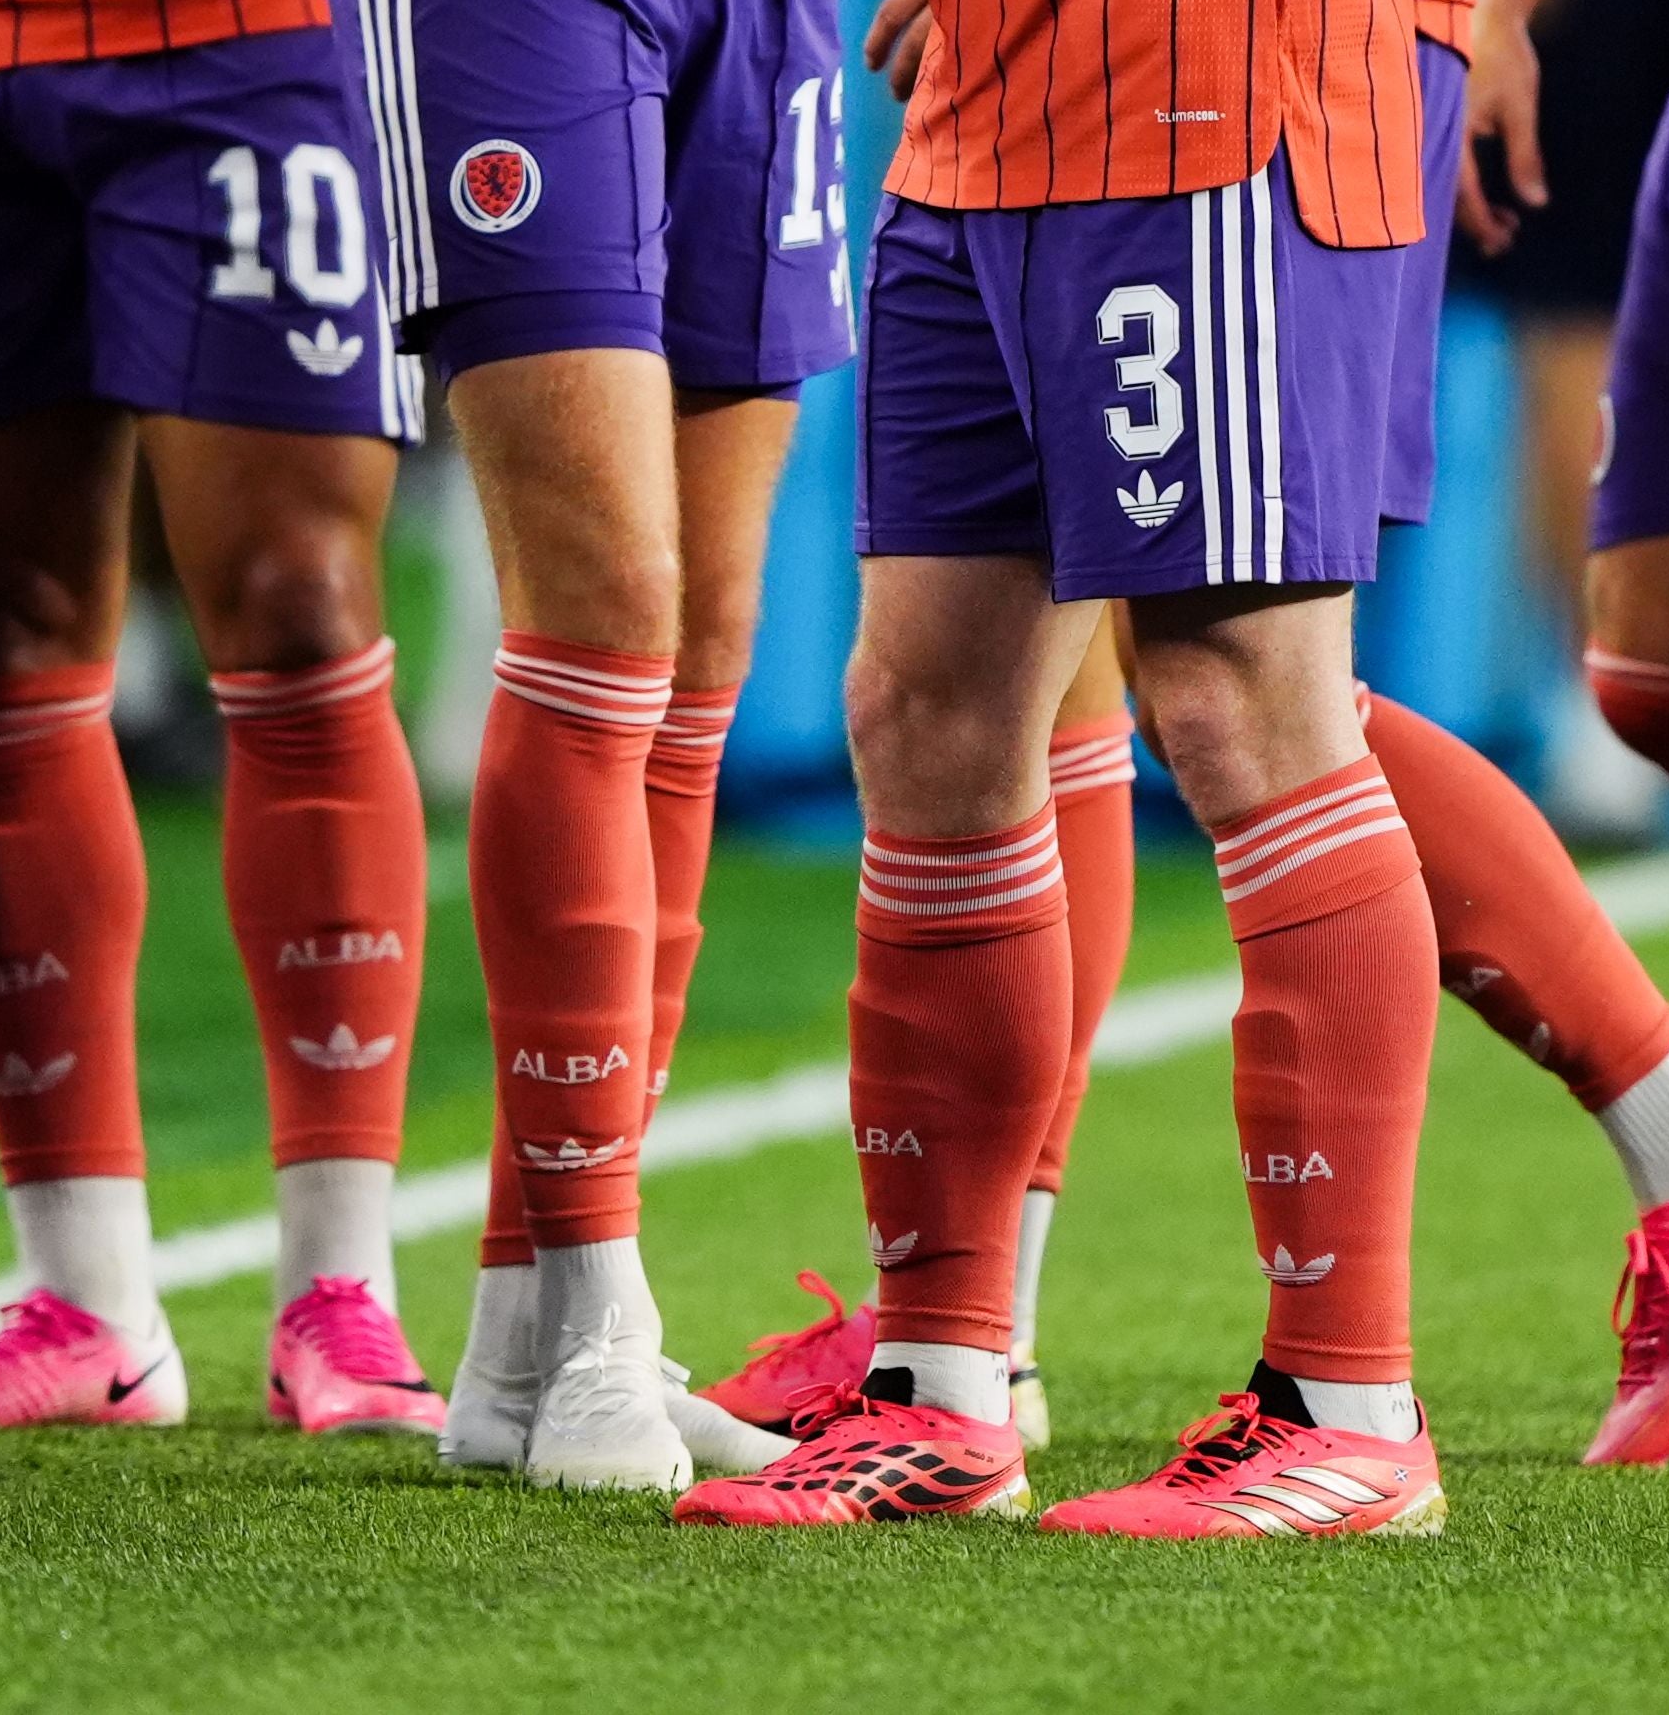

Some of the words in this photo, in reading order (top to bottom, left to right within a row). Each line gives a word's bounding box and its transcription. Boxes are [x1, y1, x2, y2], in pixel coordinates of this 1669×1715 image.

[1155, 108, 1226, 123] CLIMACOOL
[207, 142, 368, 309] 10
[1095, 283, 1185, 462] 3
[277, 929, 403, 973] ALBA
[512, 1043, 630, 1084] ALBA
[852, 1123, 923, 1158] LBA
[1242, 1150, 1334, 1184] LBA
